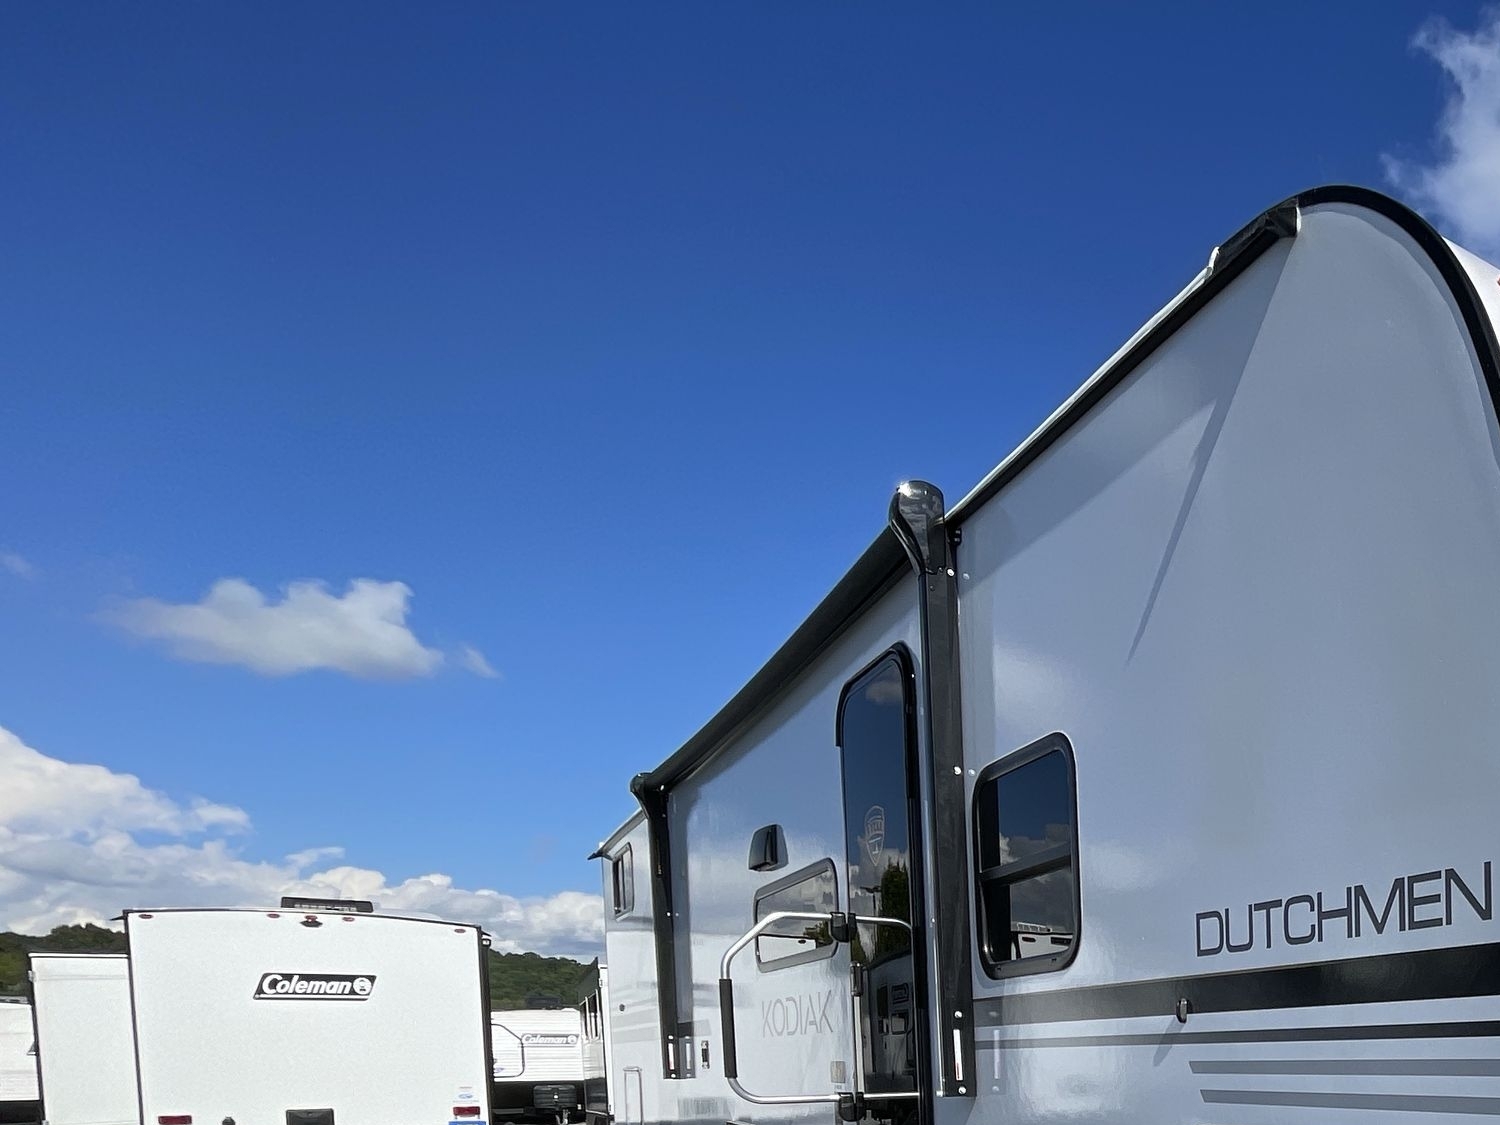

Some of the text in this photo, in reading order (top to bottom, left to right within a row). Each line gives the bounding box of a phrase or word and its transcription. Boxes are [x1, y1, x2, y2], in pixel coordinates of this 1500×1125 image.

[1195, 861, 1493, 957] DUTCHMEN
[262, 974, 352, 995] Coleman
[761, 989, 834, 1038] KODIAK
[521, 1033, 567, 1044] Coleman
